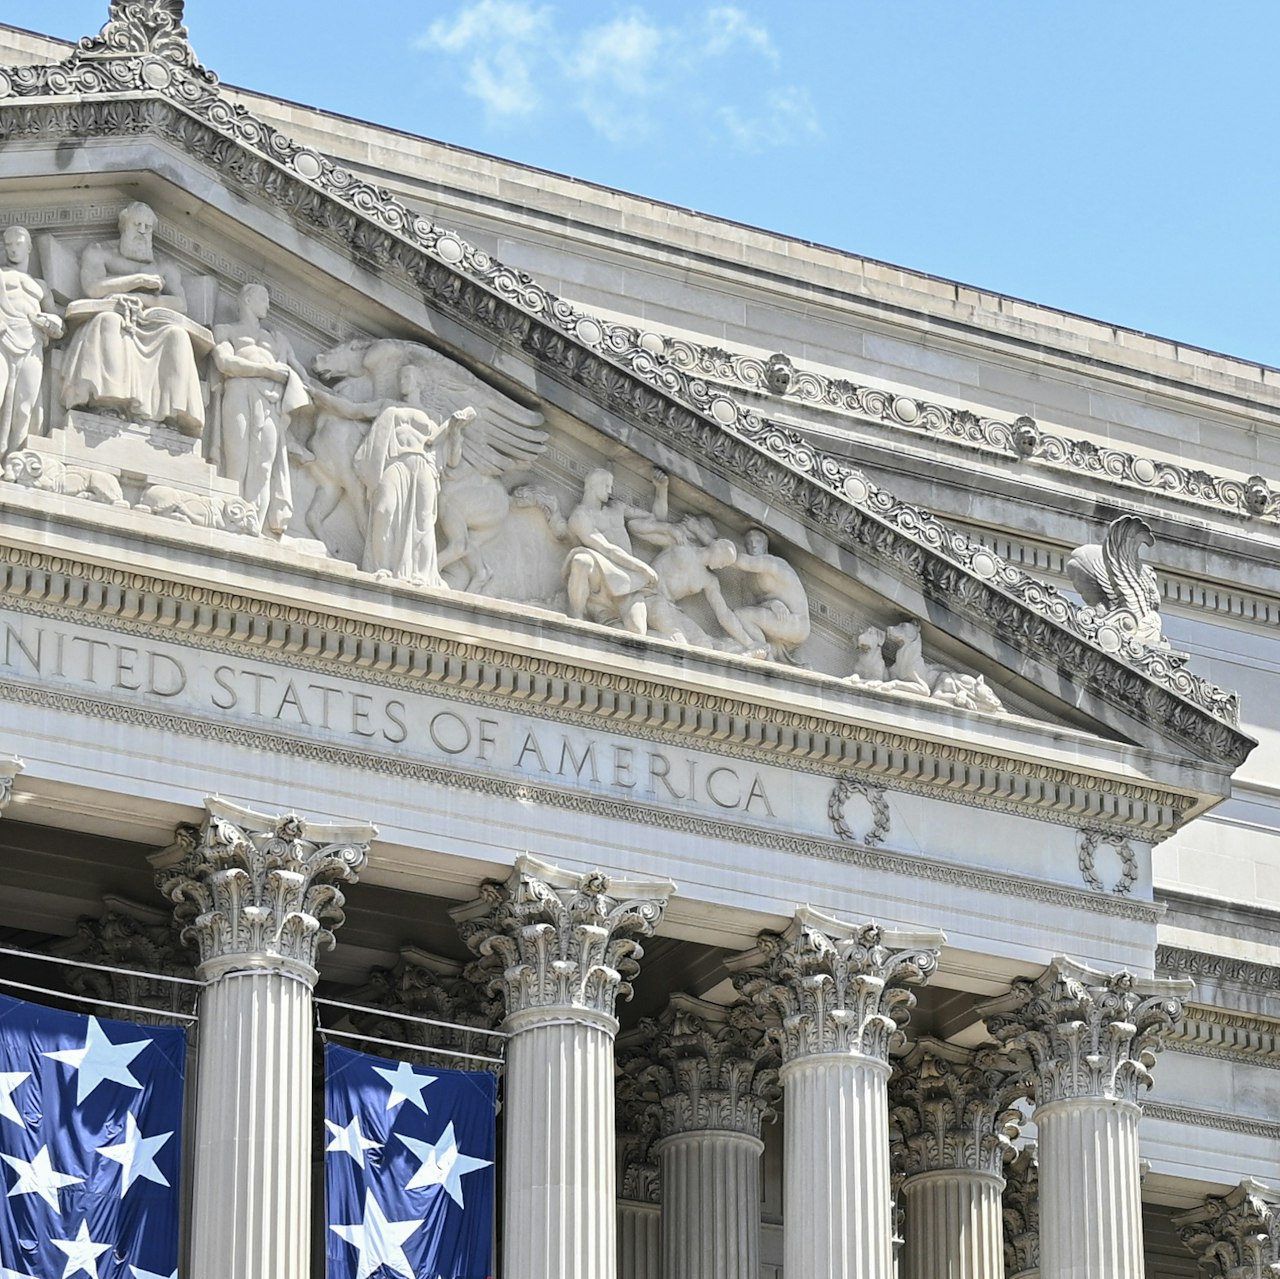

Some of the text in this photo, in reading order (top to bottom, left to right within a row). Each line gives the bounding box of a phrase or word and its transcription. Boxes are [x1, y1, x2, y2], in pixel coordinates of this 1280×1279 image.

[210, 665, 408, 743] STATES
[428, 710, 499, 761] OF
[512, 729, 777, 818] AMERICA
